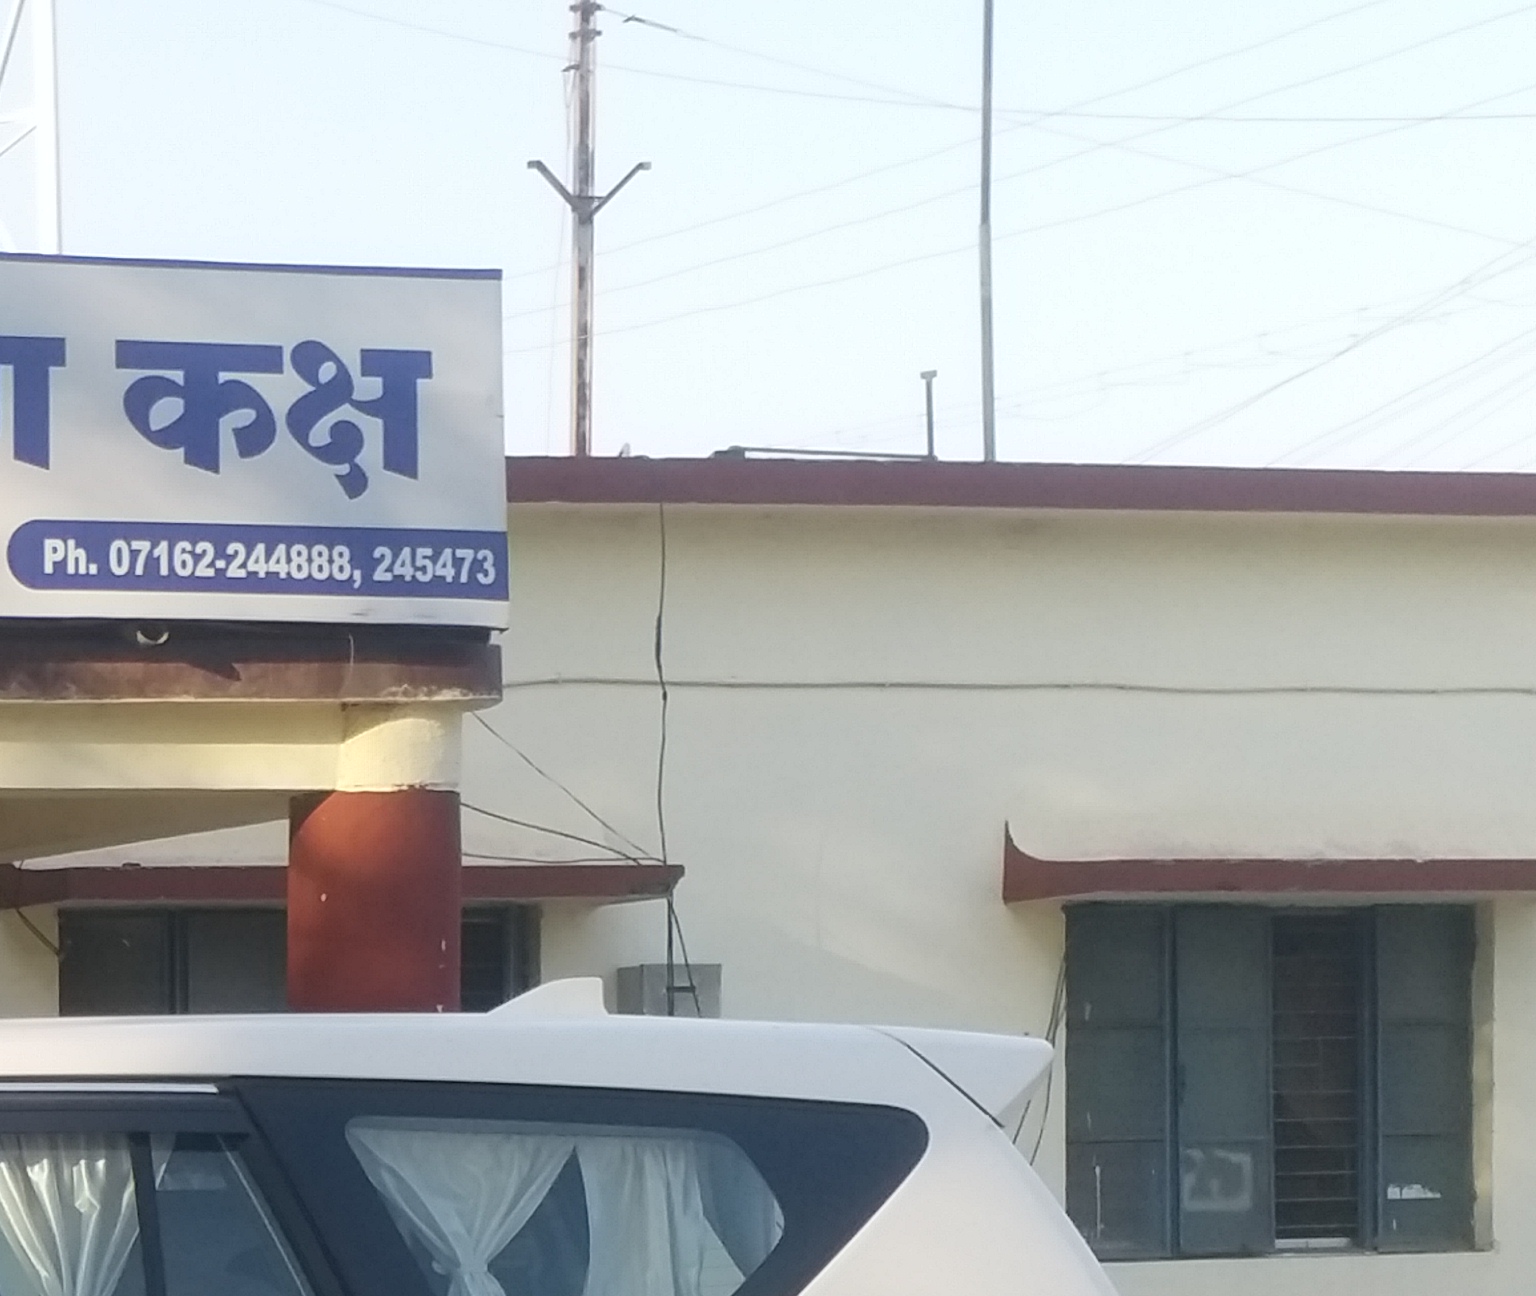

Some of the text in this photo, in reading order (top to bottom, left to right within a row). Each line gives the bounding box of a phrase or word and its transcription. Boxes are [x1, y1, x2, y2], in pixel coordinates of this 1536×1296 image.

[115, 339, 434, 500] कक्ष
[43, 538, 497, 589] Ph. 07162-244888, 245473
